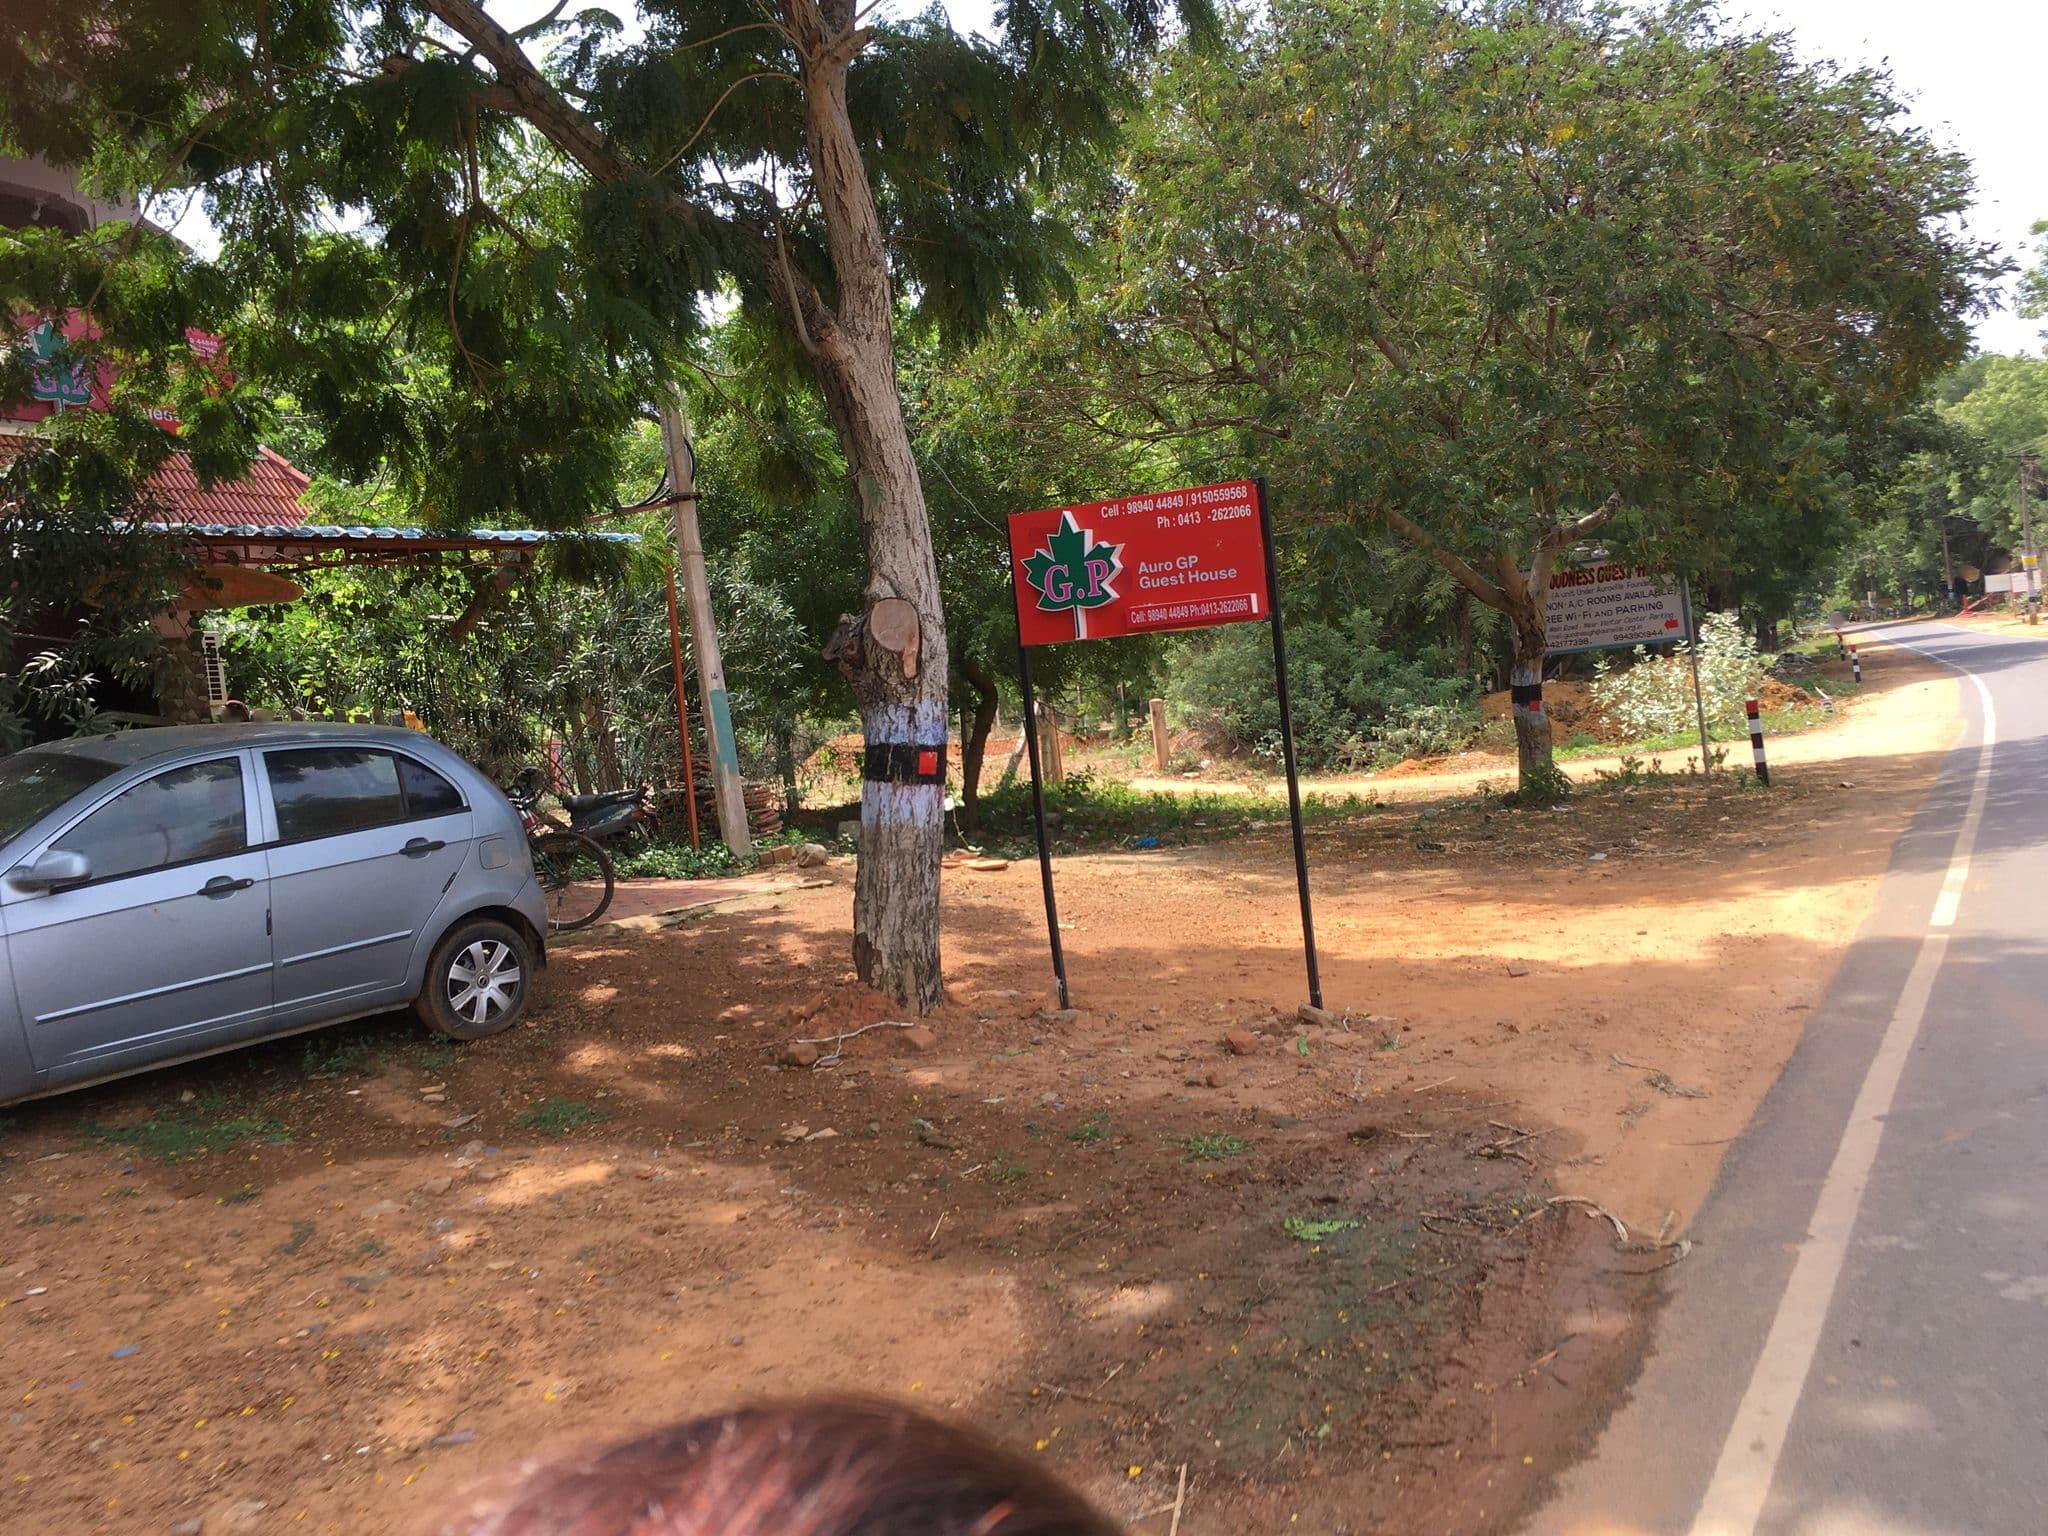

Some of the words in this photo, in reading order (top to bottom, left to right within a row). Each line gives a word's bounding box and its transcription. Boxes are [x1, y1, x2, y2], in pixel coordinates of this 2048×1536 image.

[1101, 504, 1119, 518] Cell
[1127, 499, 1154, 514] 98940
[1156, 494, 1184, 509] 44849
[1191, 486, 1248, 505] 9150559568
[1157, 515, 1170, 529] Ph
[1178, 511, 1201, 526] 0413
[1138, 561, 1173, 575] Auro
[1176, 555, 1199, 569] GP
[1044, 559, 1109, 603] G.P
[1139, 572, 1185, 589] Guest
[1188, 568, 1238, 583] House
[1549, 567, 1595, 590] OODNESS
[1587, 593, 1622, 606] ROOMS
[1545, 614, 1563, 623] REE
[1595, 609, 1613, 617] AND
[1615, 600, 1664, 614] PARKING
